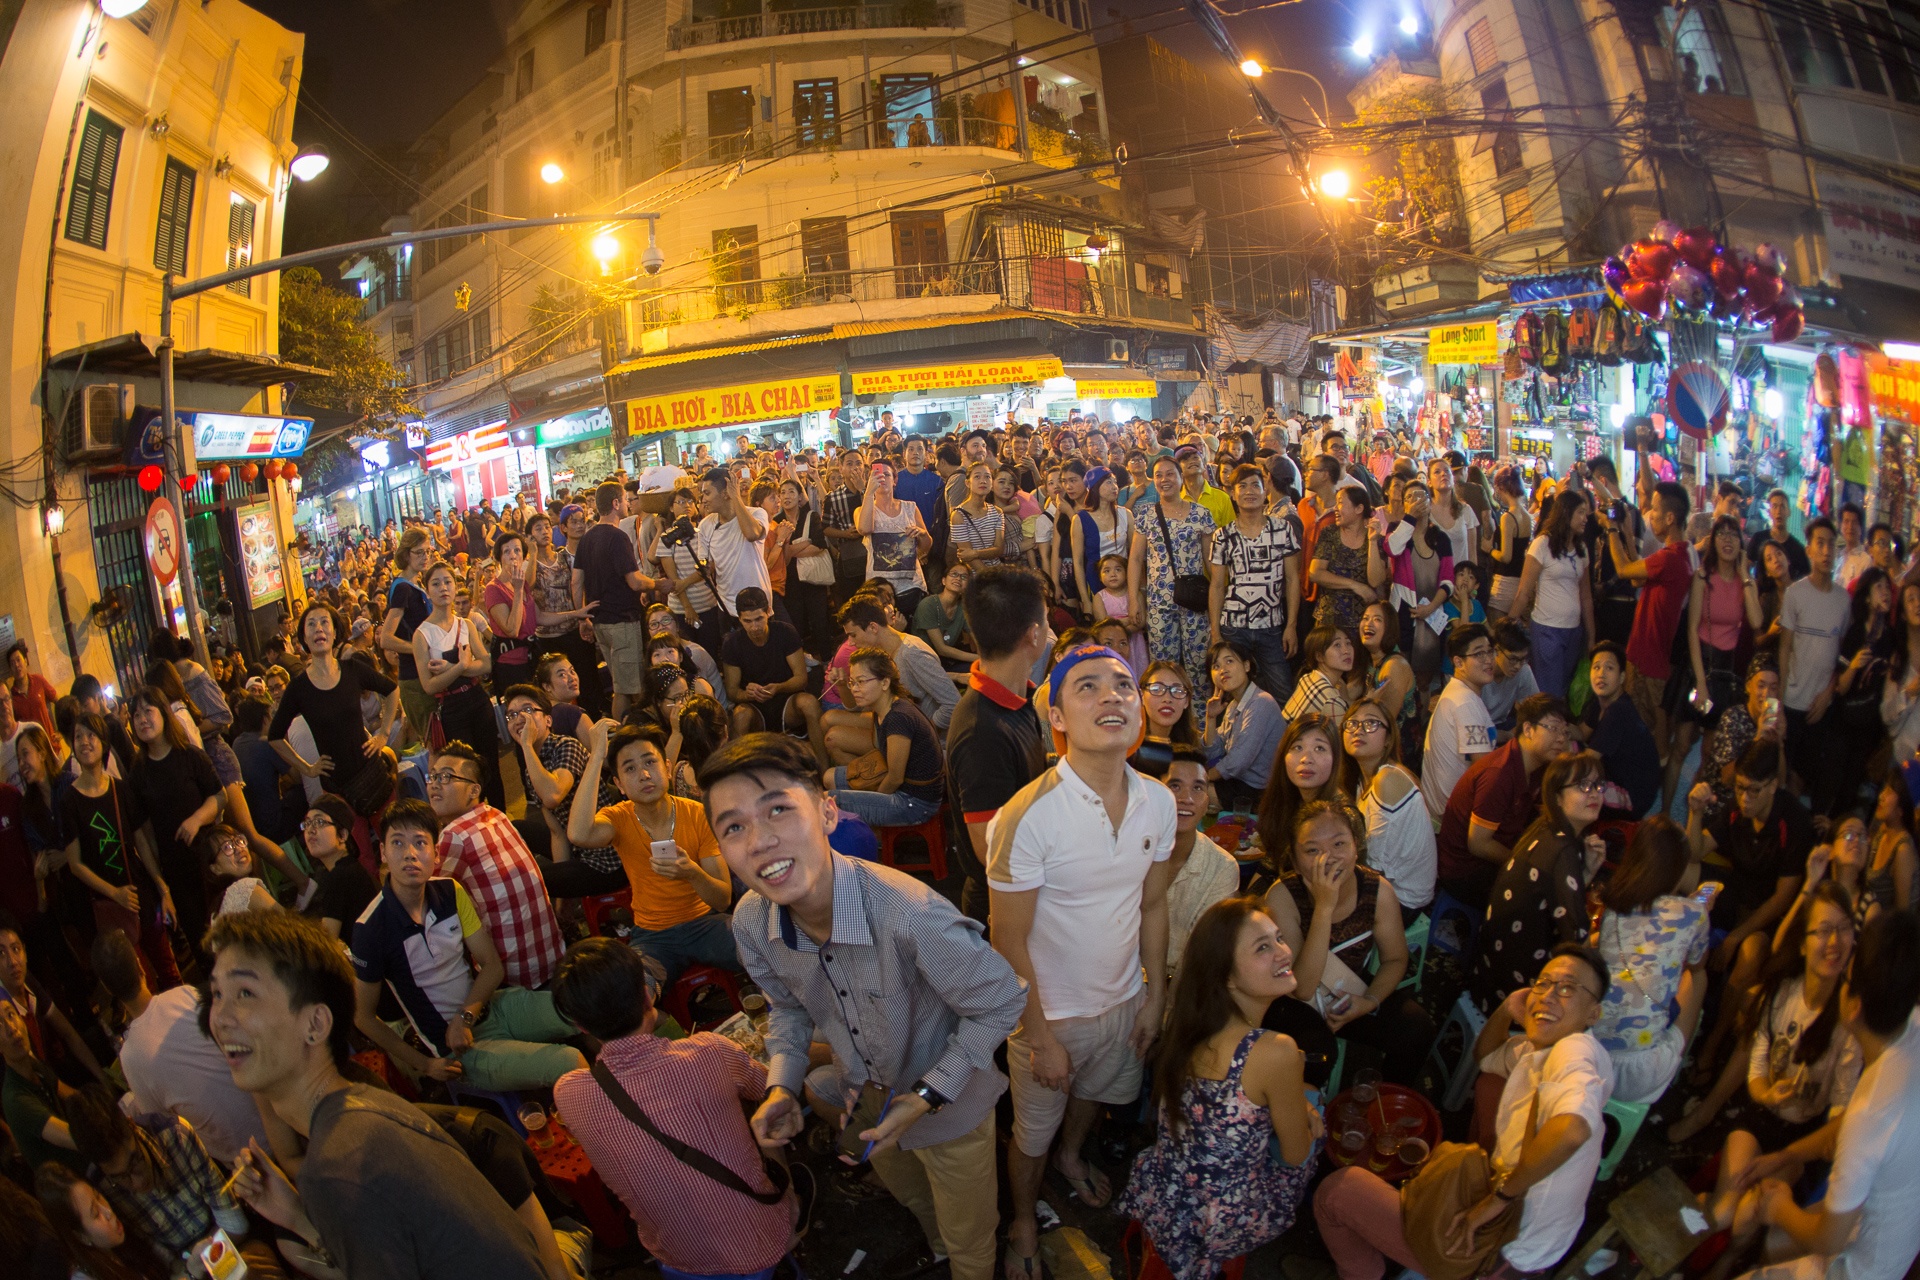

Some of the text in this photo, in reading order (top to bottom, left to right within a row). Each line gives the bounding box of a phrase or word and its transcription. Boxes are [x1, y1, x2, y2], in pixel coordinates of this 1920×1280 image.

[1441, 325, 1486, 344] Long Sport
[857, 375, 1034, 394] FRESH BEER HAI LOAN
[862, 375, 891, 386] BIA
[897, 371, 938, 383] TƯƠI
[943, 366, 973, 379] HẢI
[979, 365, 1024, 377] LOAN
[633, 405, 668, 431] BIA
[671, 395, 706, 426] HƠI
[722, 392, 756, 418] BIA
[761, 384, 811, 413] CHAI
[557, 406, 612, 438] PANDA
[228, 430, 246, 441] PEPPER
